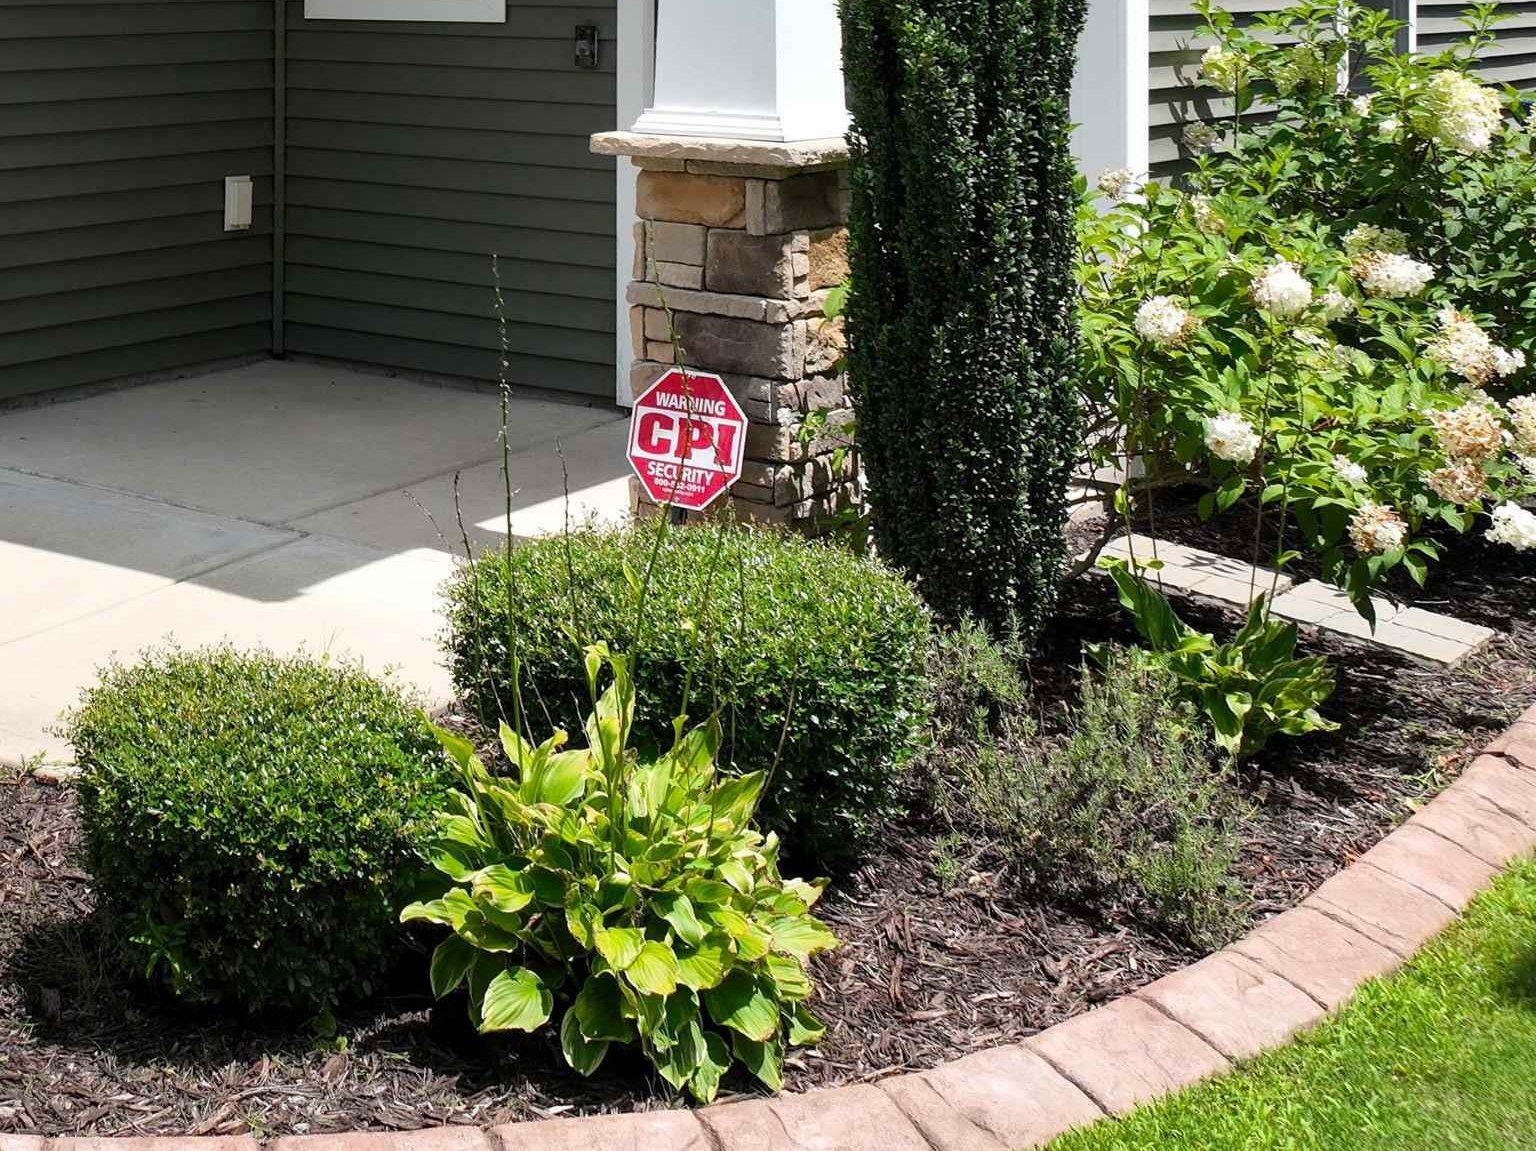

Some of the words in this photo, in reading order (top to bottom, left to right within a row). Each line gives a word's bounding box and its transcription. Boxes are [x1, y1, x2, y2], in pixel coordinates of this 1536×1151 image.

[656, 391, 726, 416] WARNING
[638, 413, 736, 467] CPI
[647, 461, 714, 486] SECURITY
